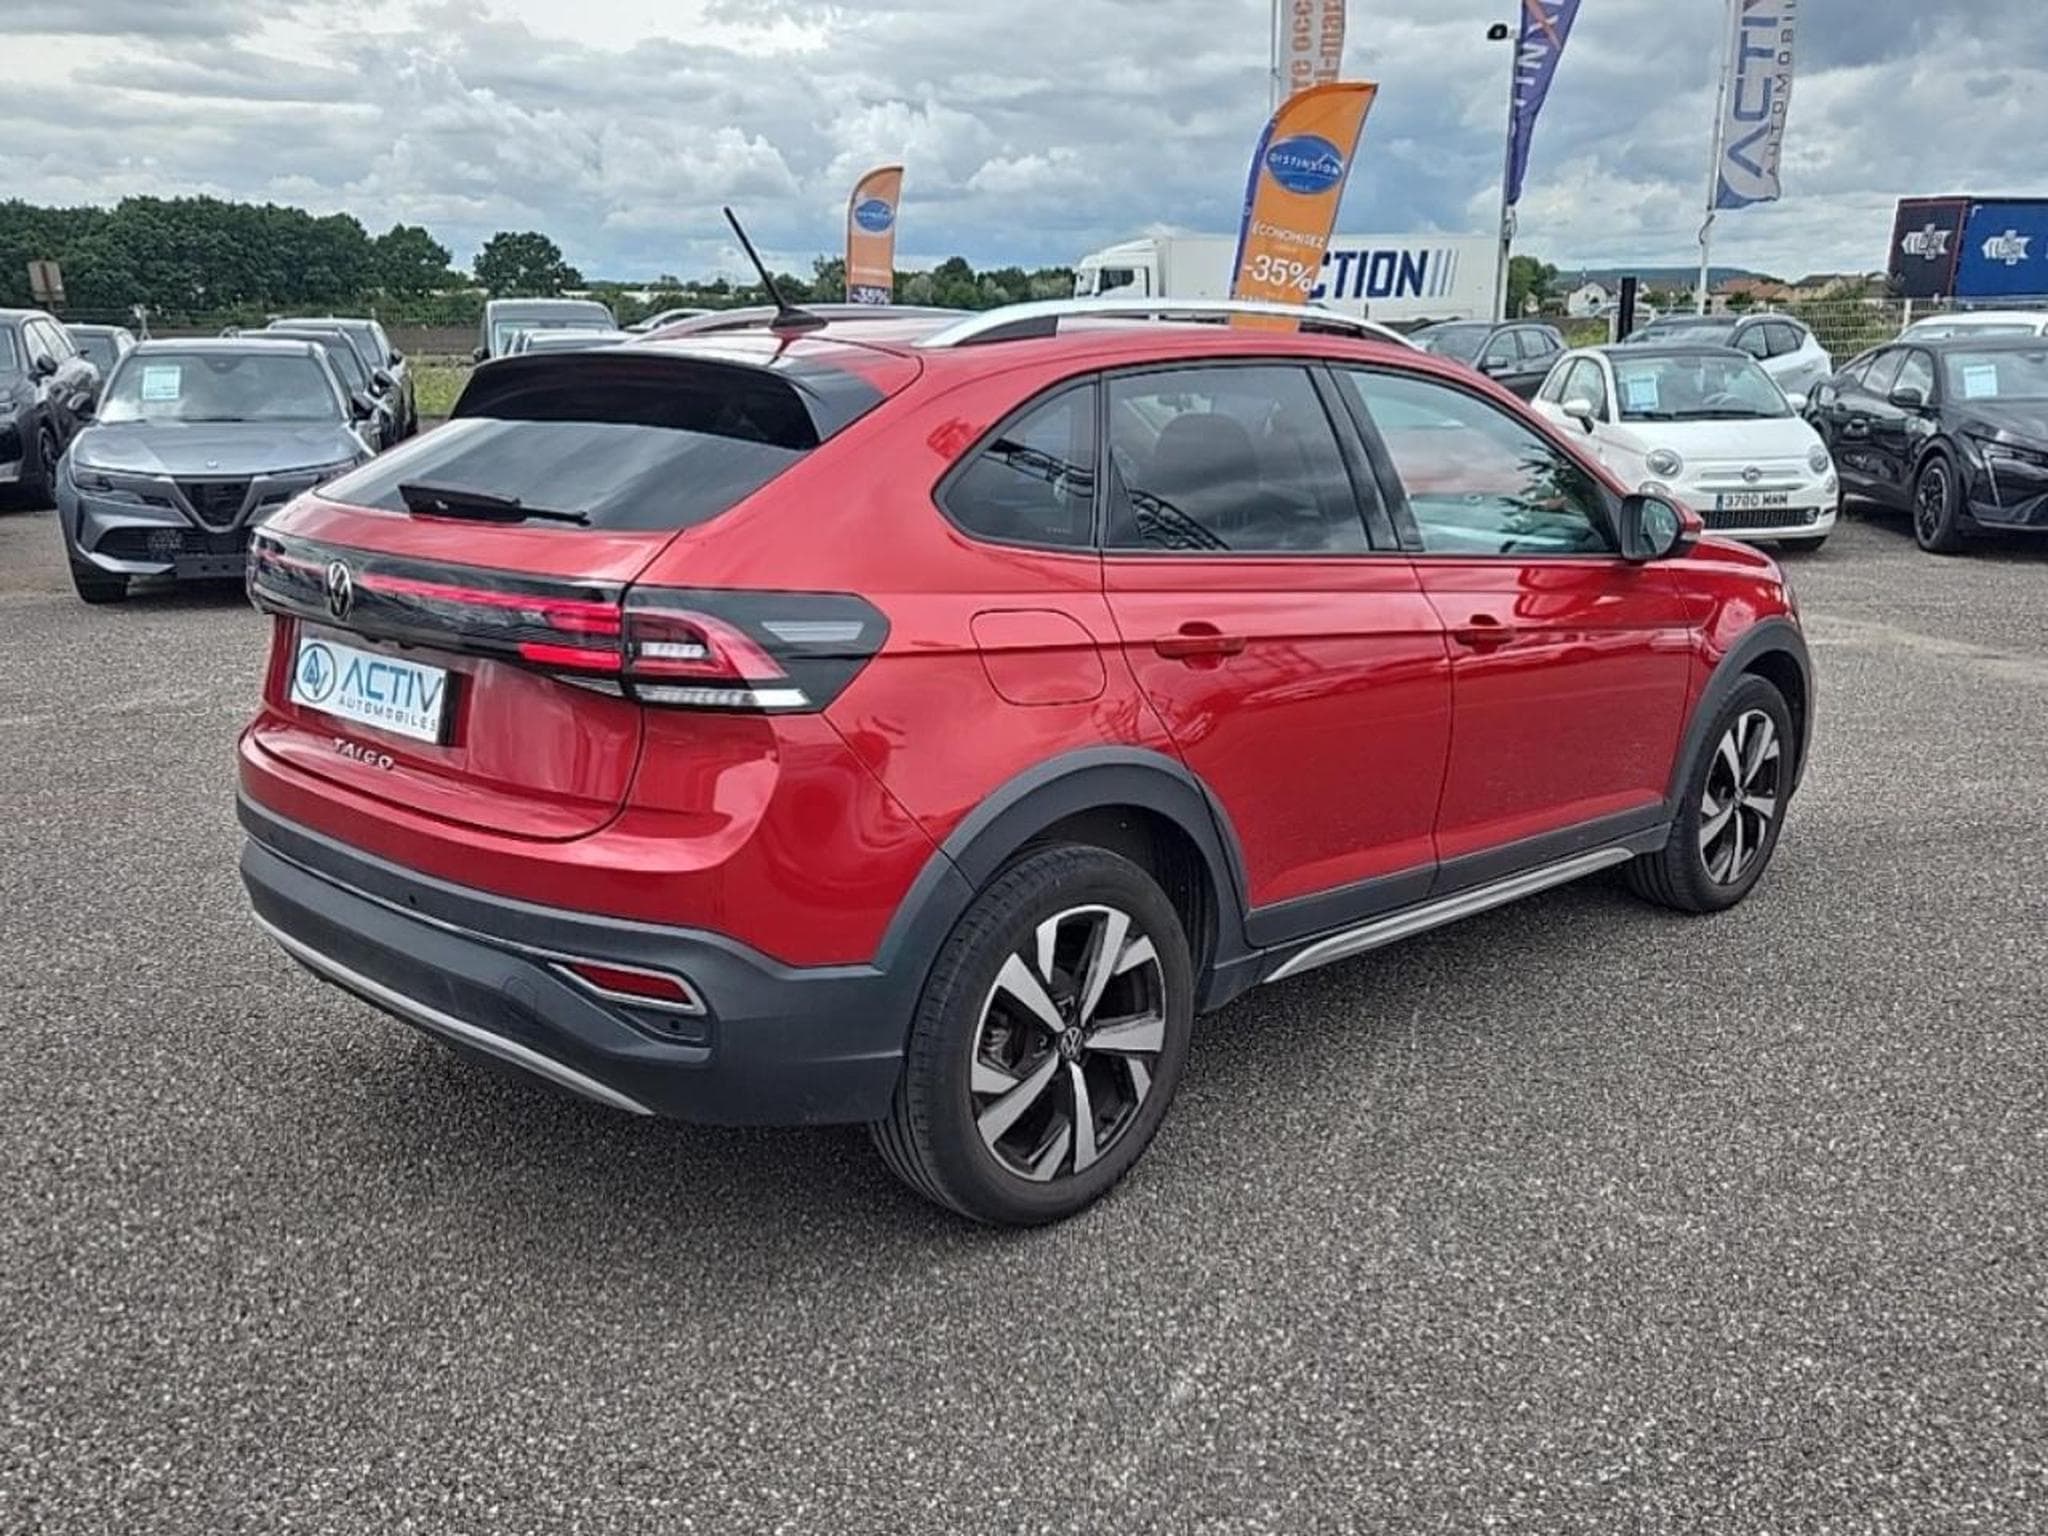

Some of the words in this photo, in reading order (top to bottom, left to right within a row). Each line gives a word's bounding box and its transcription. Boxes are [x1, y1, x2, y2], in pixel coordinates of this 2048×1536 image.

[1243, 253, 1315, 293] -35%
[341, 656, 443, 714] ACTIV
[339, 696, 437, 733] AUTOMOBILES
[332, 737, 395, 770] TAIGO
